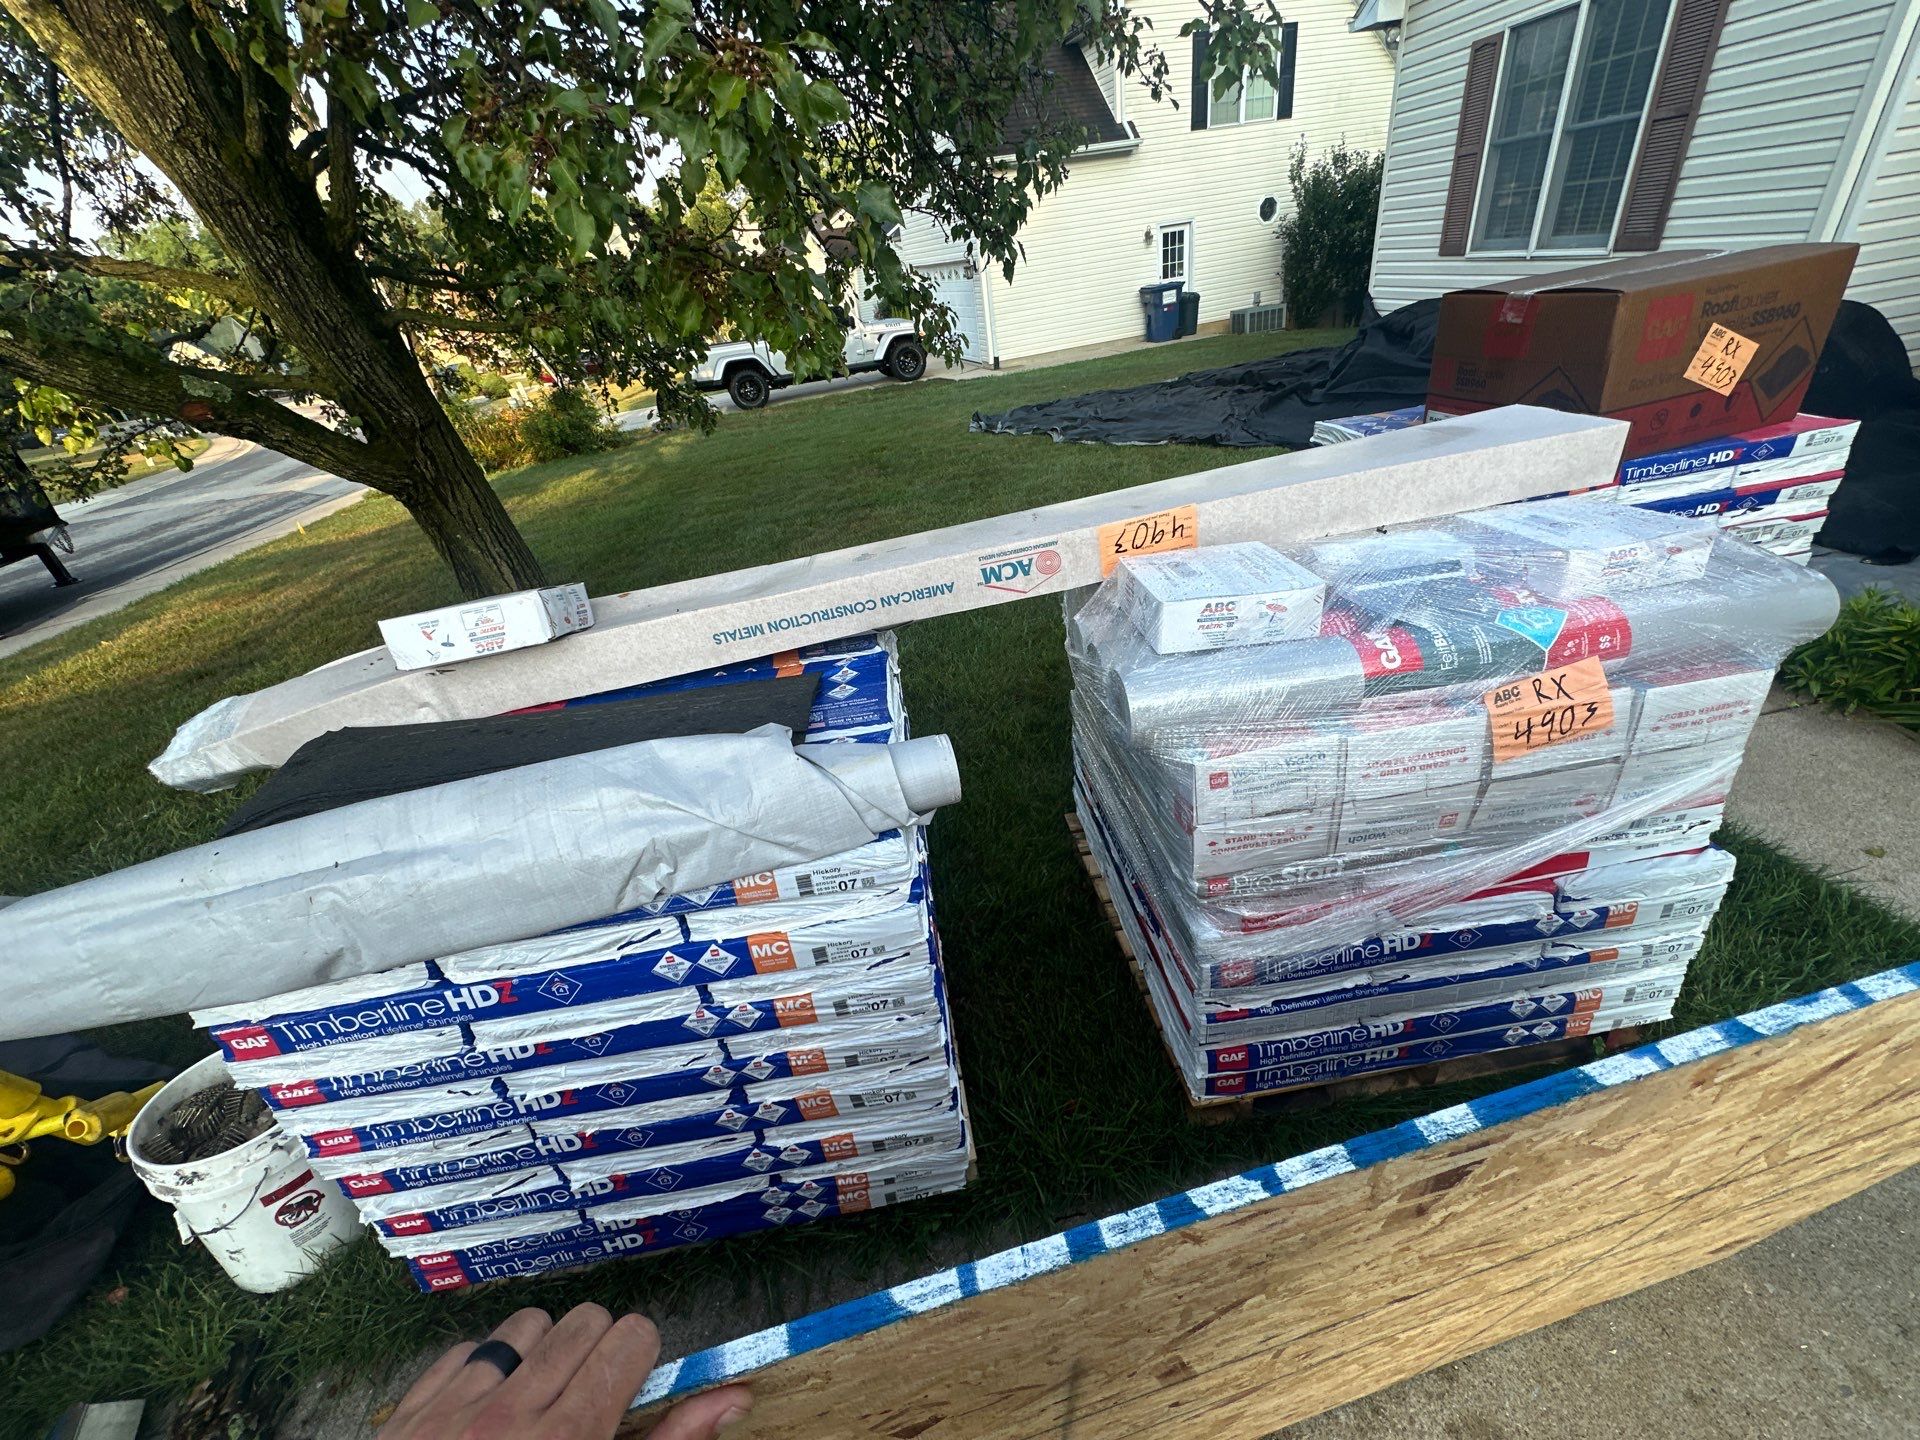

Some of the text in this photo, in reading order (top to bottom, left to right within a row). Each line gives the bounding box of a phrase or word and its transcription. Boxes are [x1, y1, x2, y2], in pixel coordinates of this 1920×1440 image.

[1712, 327, 1726, 338] ABC
[1721, 337, 1741, 359] RX
[1700, 356, 1736, 389] 4903
[1114, 515, 1185, 554] 4903
[978, 540, 1058, 562] AMERICAN CONSTRUCTION METALS
[980, 557, 1033, 585] ACM
[712, 581, 954, 645] AMERICAN CONSTRUCTION METALS
[1200, 601, 1236, 614] ABC
[475, 637, 505, 654] ABC
[1494, 685, 1521, 704] ABC
[1532, 674, 1574, 704] RX
[1514, 701, 1598, 744] 4903
[812, 866, 841, 877] Hickory
[734, 872, 774, 889] MC
[838, 878, 857, 892] 07
[1609, 901, 1638, 916] MC
[1687, 905, 1703, 914] 07
[750, 940, 790, 960] MC
[827, 939, 853, 948] Hickory
[1668, 944, 1682, 953] 07
[851, 947, 868, 959] 07
[1363, 953, 1398, 968] Shingles
[1575, 988, 1602, 1002] MC
[1648, 989, 1662, 999] 07
[775, 998, 814, 1014] MC
[871, 999, 889, 1012] 07
[1260, 1004, 1280, 1015] High
[1280, 997, 1319, 1013] Definition
[295, 1039, 322, 1053] High
[428, 1012, 474, 1031] Shingles
[231, 1034, 270, 1050] GAF
[789, 1051, 823, 1067] MC
[1218, 1051, 1246, 1063] GAF
[1260, 1057, 1279, 1067] High
[1279, 1050, 1318, 1063] Definition
[339, 1085, 367, 1098] High
[468, 1062, 513, 1078] Shingles
[1216, 1076, 1244, 1088] GAF
[277, 1084, 319, 1100] GAF
[884, 1092, 902, 1104] 07
[799, 1094, 833, 1110] MC
[496, 1113, 539, 1128] Shingles
[319, 1133, 354, 1147] GAF
[823, 1138, 856, 1154] MC
[904, 1137, 921, 1148] 07
[349, 1176, 383, 1190] GAF
[405, 1174, 430, 1188] High
[838, 1173, 868, 1187] MC
[838, 1189, 868, 1204] MC
[420, 1254, 452, 1267] GAF
[431, 1274, 463, 1287] GAF
